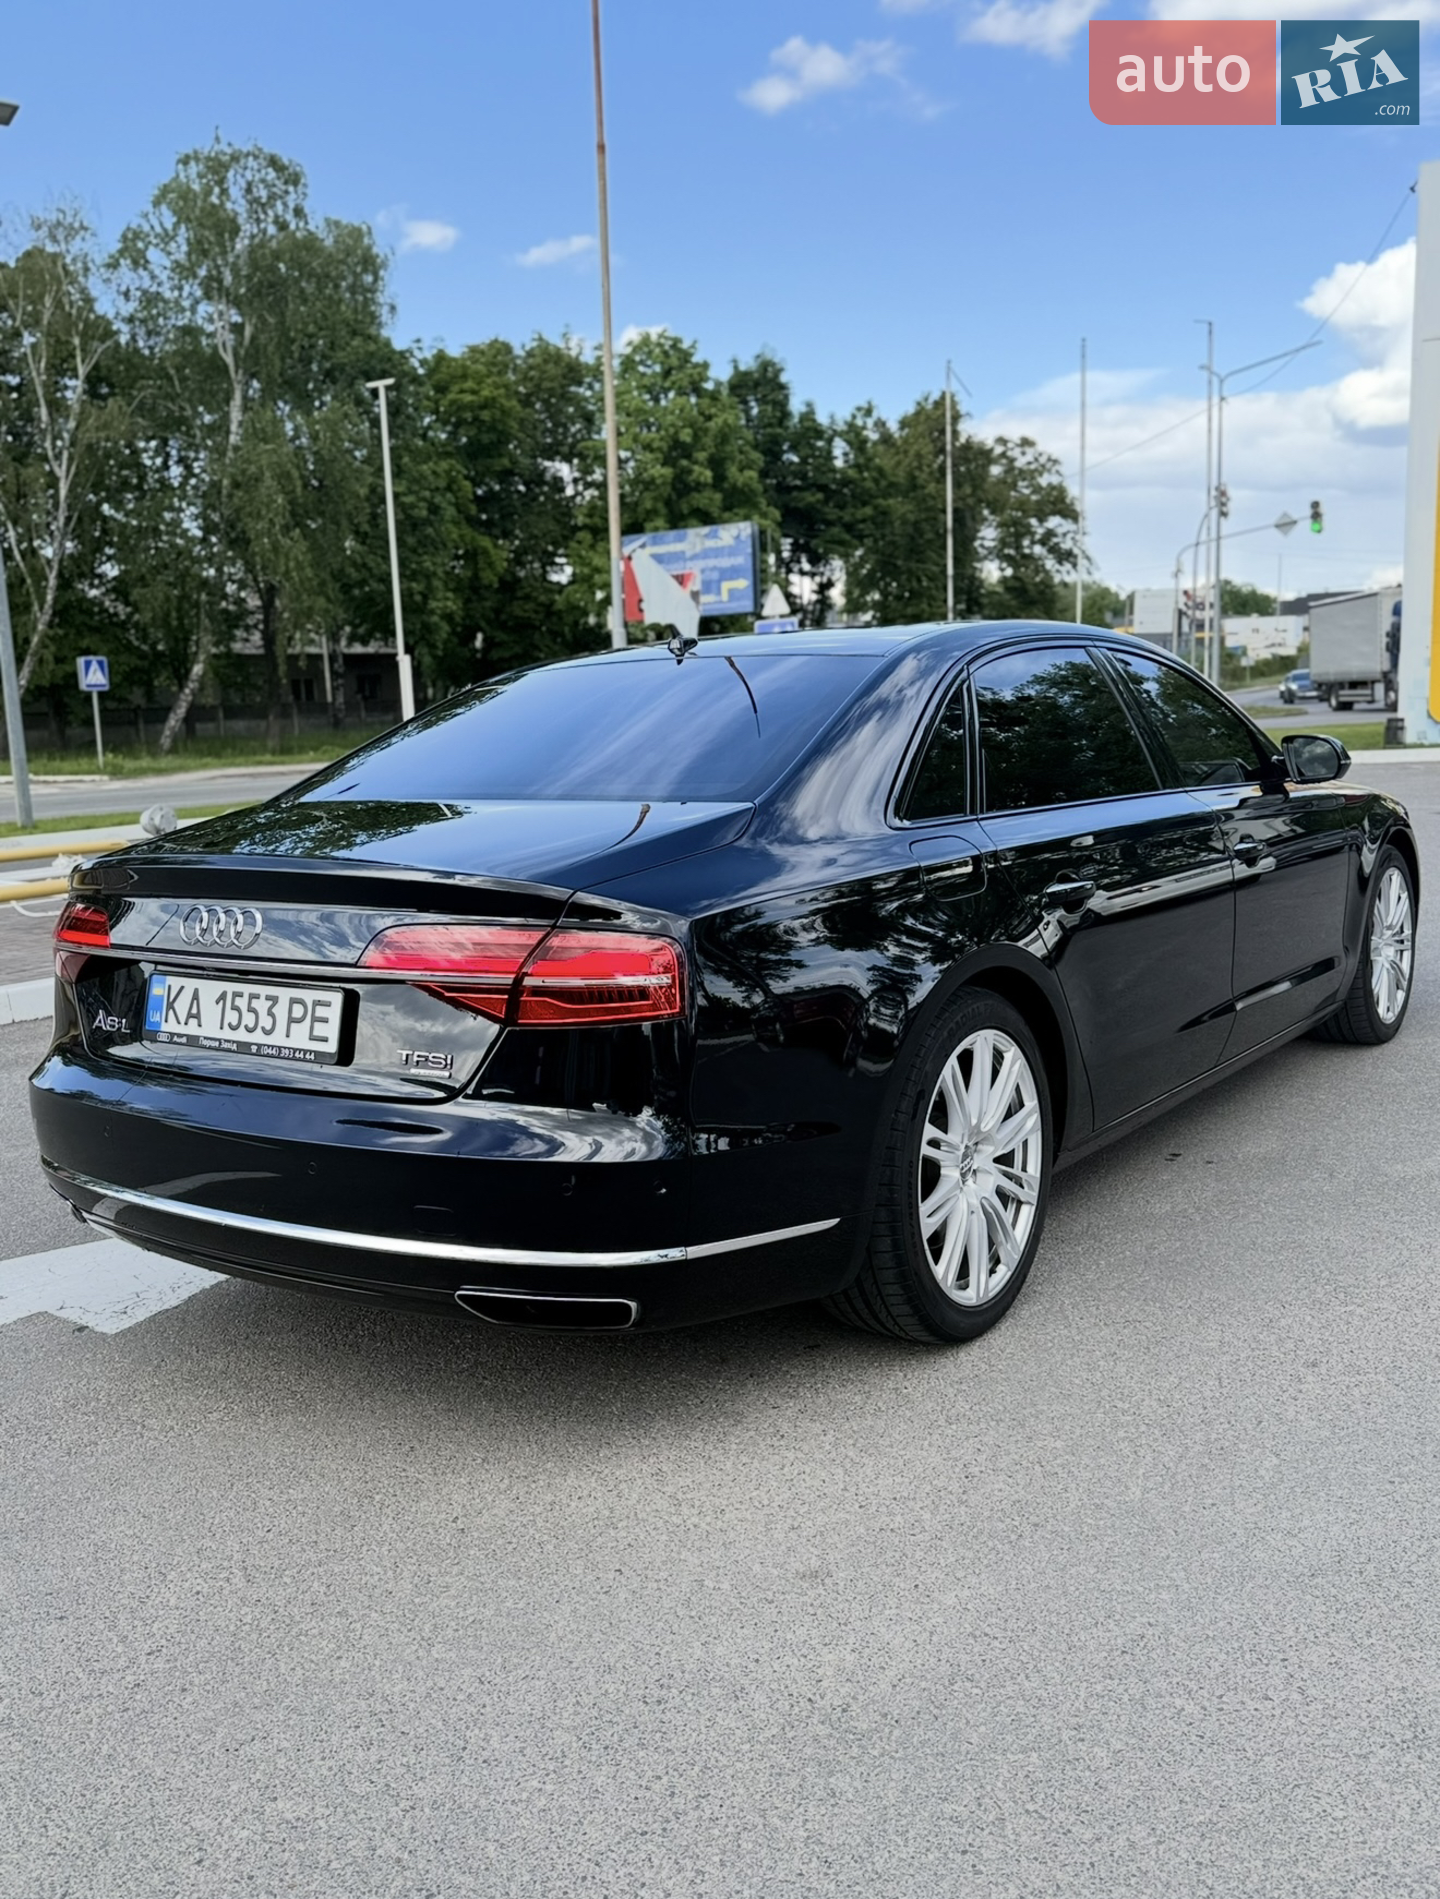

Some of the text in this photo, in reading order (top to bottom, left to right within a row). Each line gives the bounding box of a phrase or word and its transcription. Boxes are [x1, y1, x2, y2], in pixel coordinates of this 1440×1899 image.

[149, 1010, 161, 1023] UA
[164, 984, 332, 1043] KA 1553 PE
[172, 1035, 315, 1061] Audi Порше Захід (044) 393 44 44
[396, 1049, 453, 1070] TFSI
